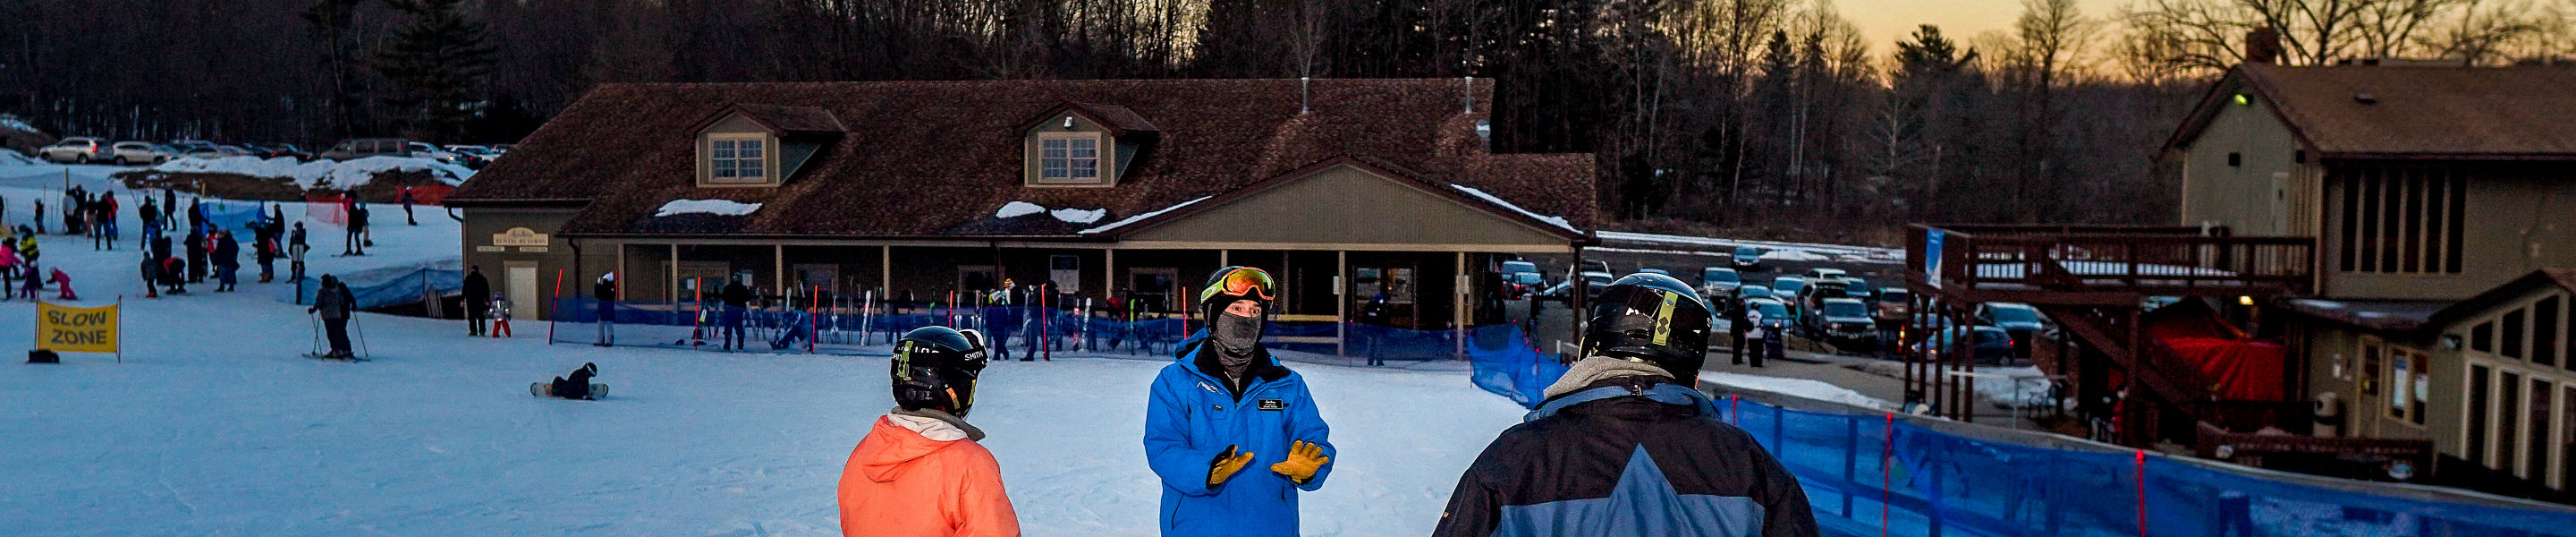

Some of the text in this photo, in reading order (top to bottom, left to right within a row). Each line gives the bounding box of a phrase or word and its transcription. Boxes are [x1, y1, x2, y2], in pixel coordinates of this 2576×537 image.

[47, 310, 106, 327] SLOW
[51, 329, 107, 345] ZONE
[964, 350, 984, 361] SMITH
